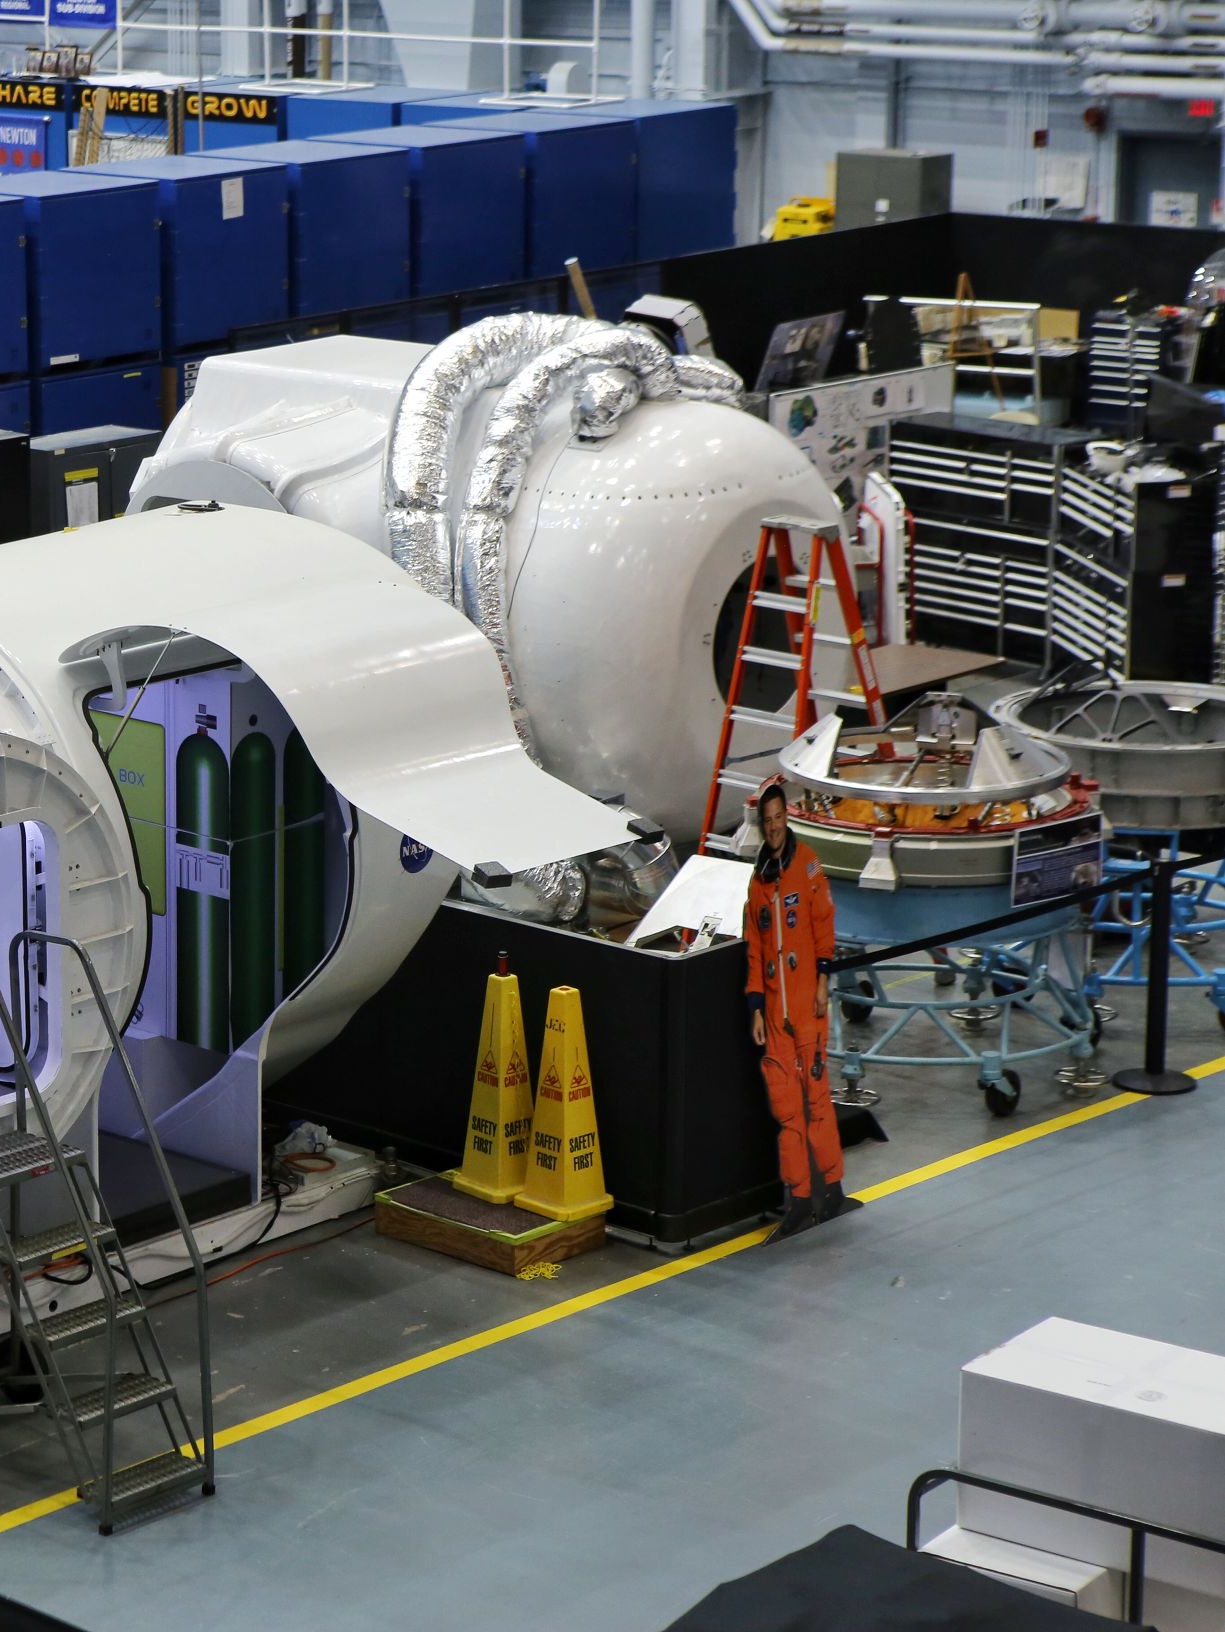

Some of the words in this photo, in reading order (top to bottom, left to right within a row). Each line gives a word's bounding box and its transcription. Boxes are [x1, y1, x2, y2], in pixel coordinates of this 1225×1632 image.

[186, 95, 268, 119] GROW
[0, 126, 38, 145] NEWTON
[119, 768, 145, 787] BOX
[402, 844, 425, 857] NAS
[478, 1071, 499, 1088] CAUTION
[540, 1086, 563, 1102] CAUTION
[568, 1086, 591, 1102] CAUTION
[471, 1115, 497, 1137] SAFETY
[473, 1137, 493, 1155] FIRST
[534, 1131, 562, 1153] SAFETY
[569, 1132, 596, 1153] SAFETY
[536, 1152, 558, 1171] FIRST
[573, 1152, 594, 1171] FIRST
